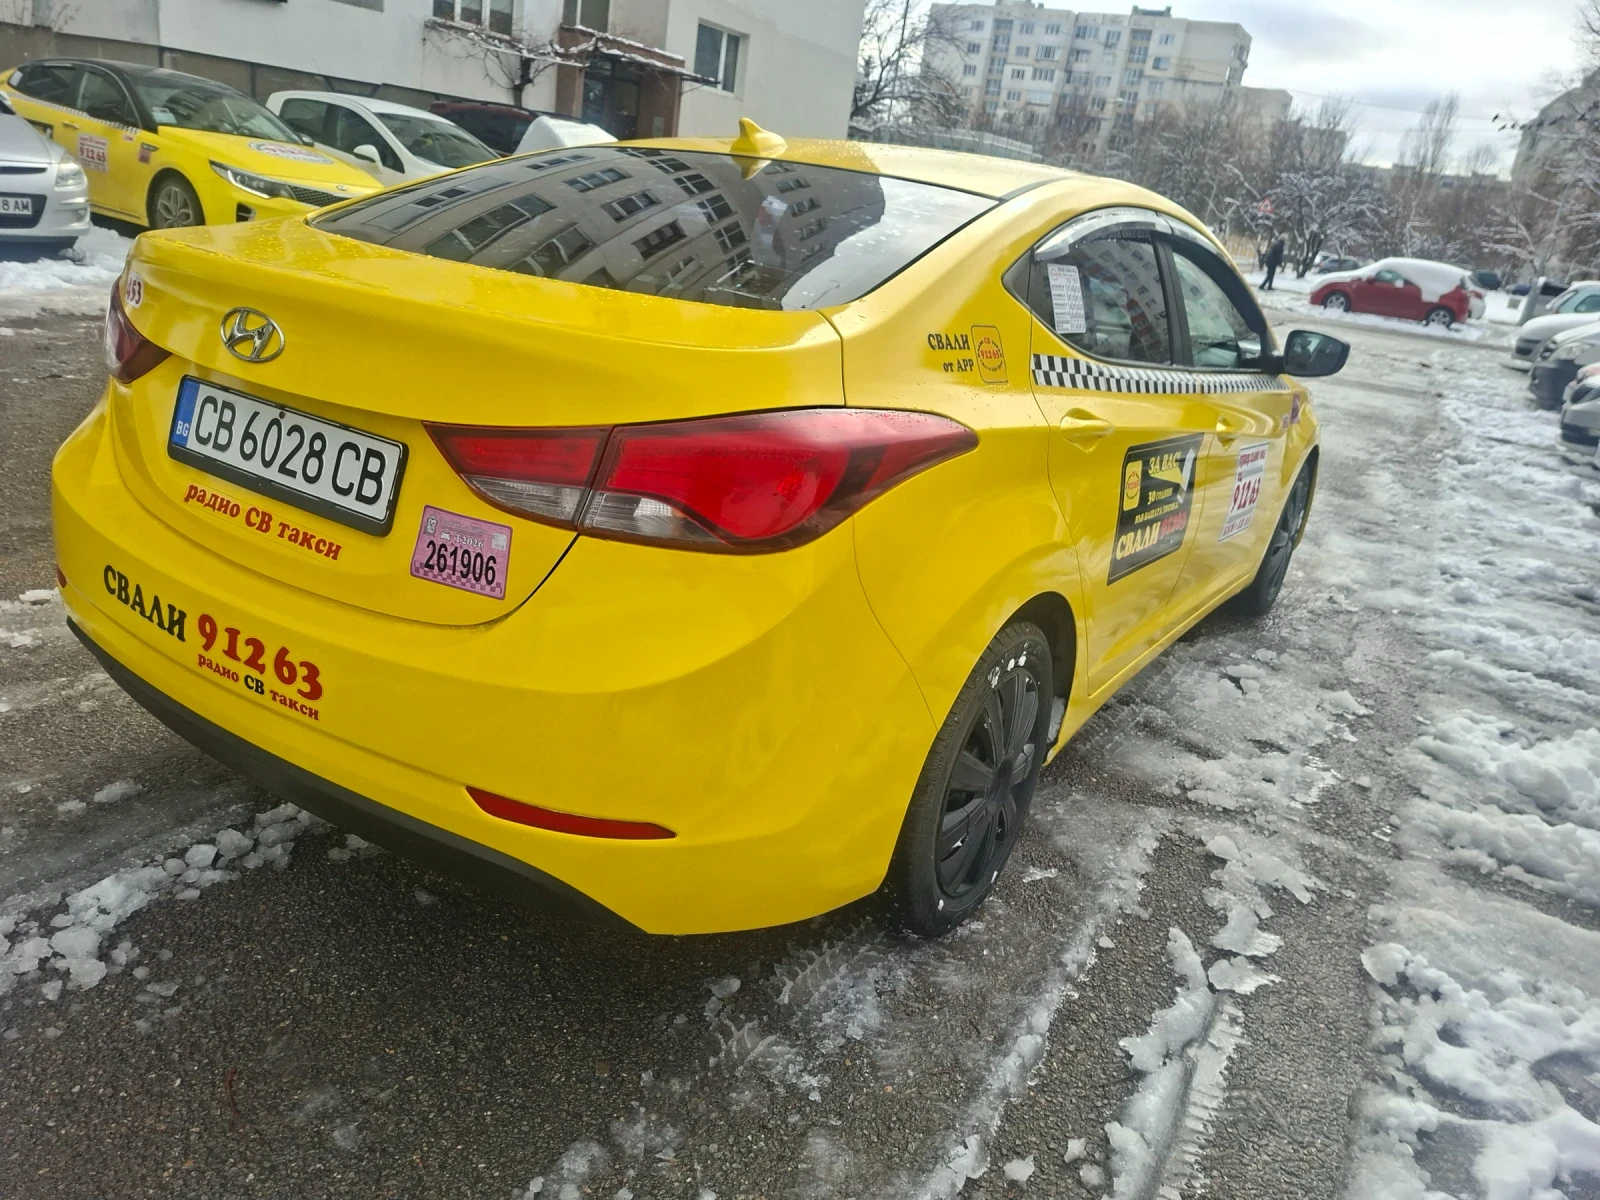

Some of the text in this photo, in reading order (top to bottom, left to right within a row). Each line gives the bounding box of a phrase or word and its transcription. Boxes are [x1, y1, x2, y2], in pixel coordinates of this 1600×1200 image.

[13, 200, 31, 213] AM
[927, 333, 971, 351] СВАЛИ
[943, 361, 954, 373] от
[176, 395, 387, 506] BG CB 6028 CB
[1147, 456, 1161, 476] ЗА
[183, 483, 343, 561] радио СВ такси
[1115, 521, 1161, 561] СВАЛИ
[424, 539, 497, 586] 261906
[103, 564, 188, 643] СВАЛИ
[197, 653, 319, 721] радио СВ такси
